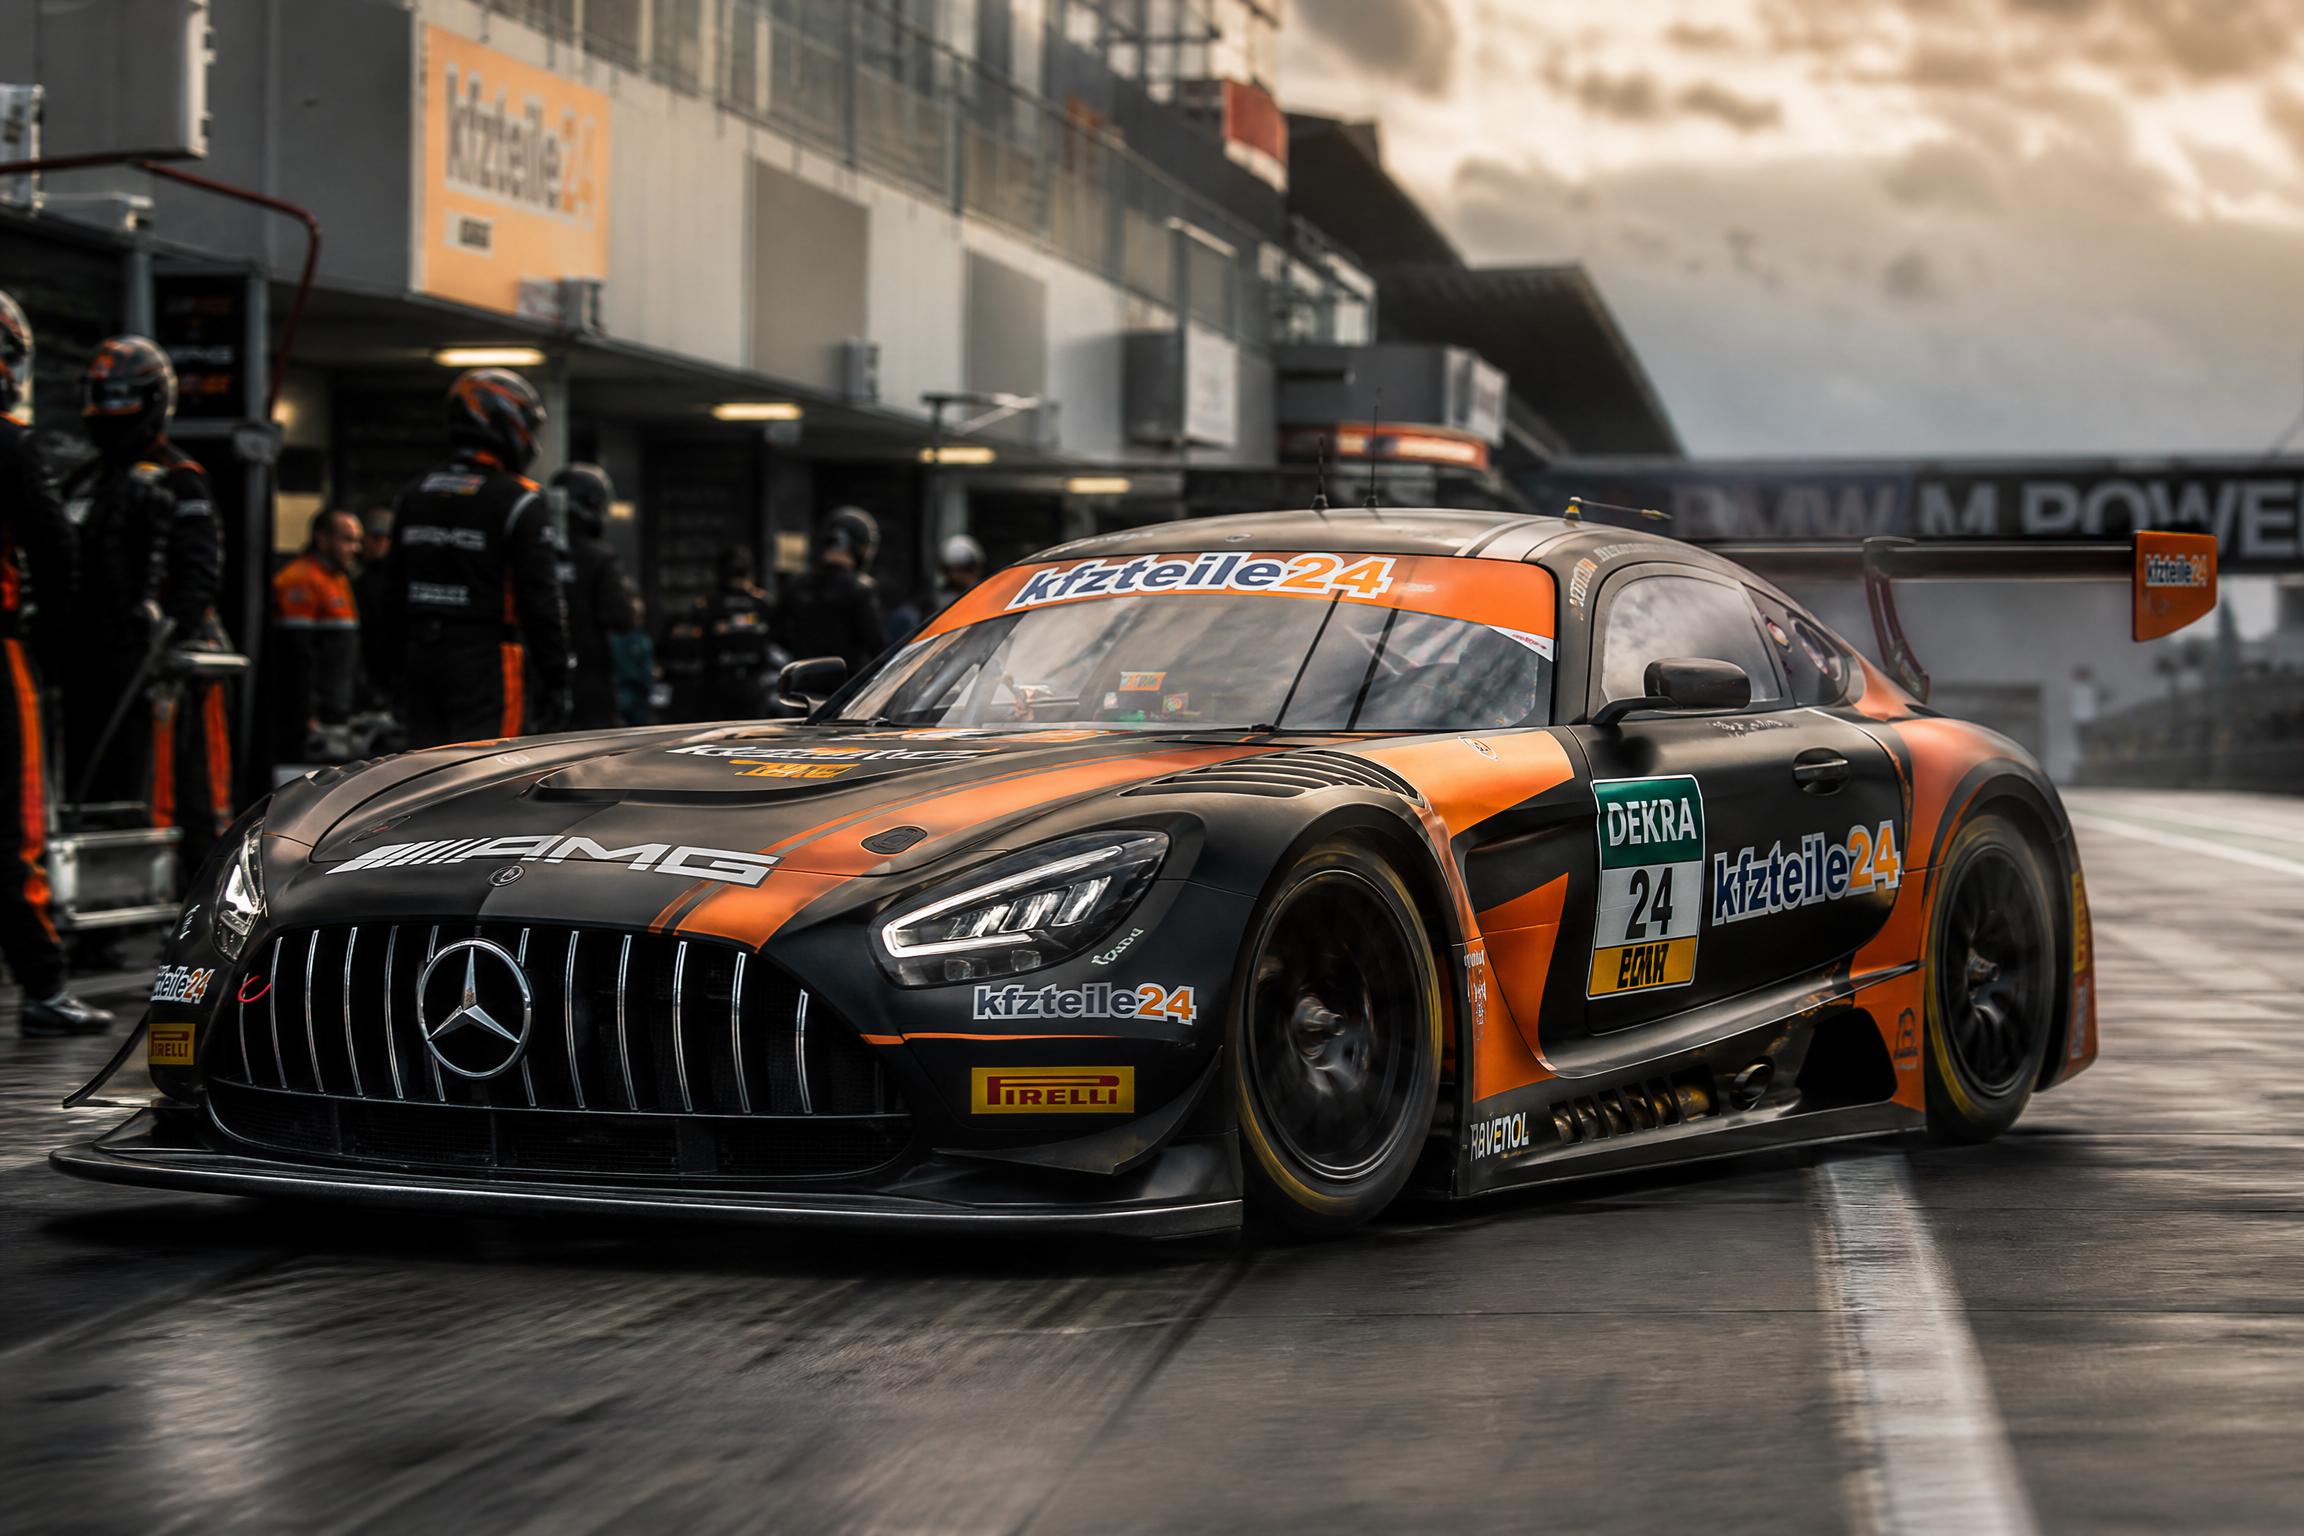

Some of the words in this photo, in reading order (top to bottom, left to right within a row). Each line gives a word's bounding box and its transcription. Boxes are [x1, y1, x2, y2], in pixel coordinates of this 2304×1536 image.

[2022, 479, 2304, 560] POWE
[1004, 551, 1396, 611] kfzteile24
[2145, 553, 2208, 587] kfzteile24
[1607, 797, 1697, 847] DEKRA
[1711, 818, 1905, 926] kfzteile24
[1624, 866, 1674, 941] 24
[151, 964, 215, 1004] teile24
[973, 982, 1197, 1026] kfzteile24
[987, 1075, 1120, 1105] PIRELLI
